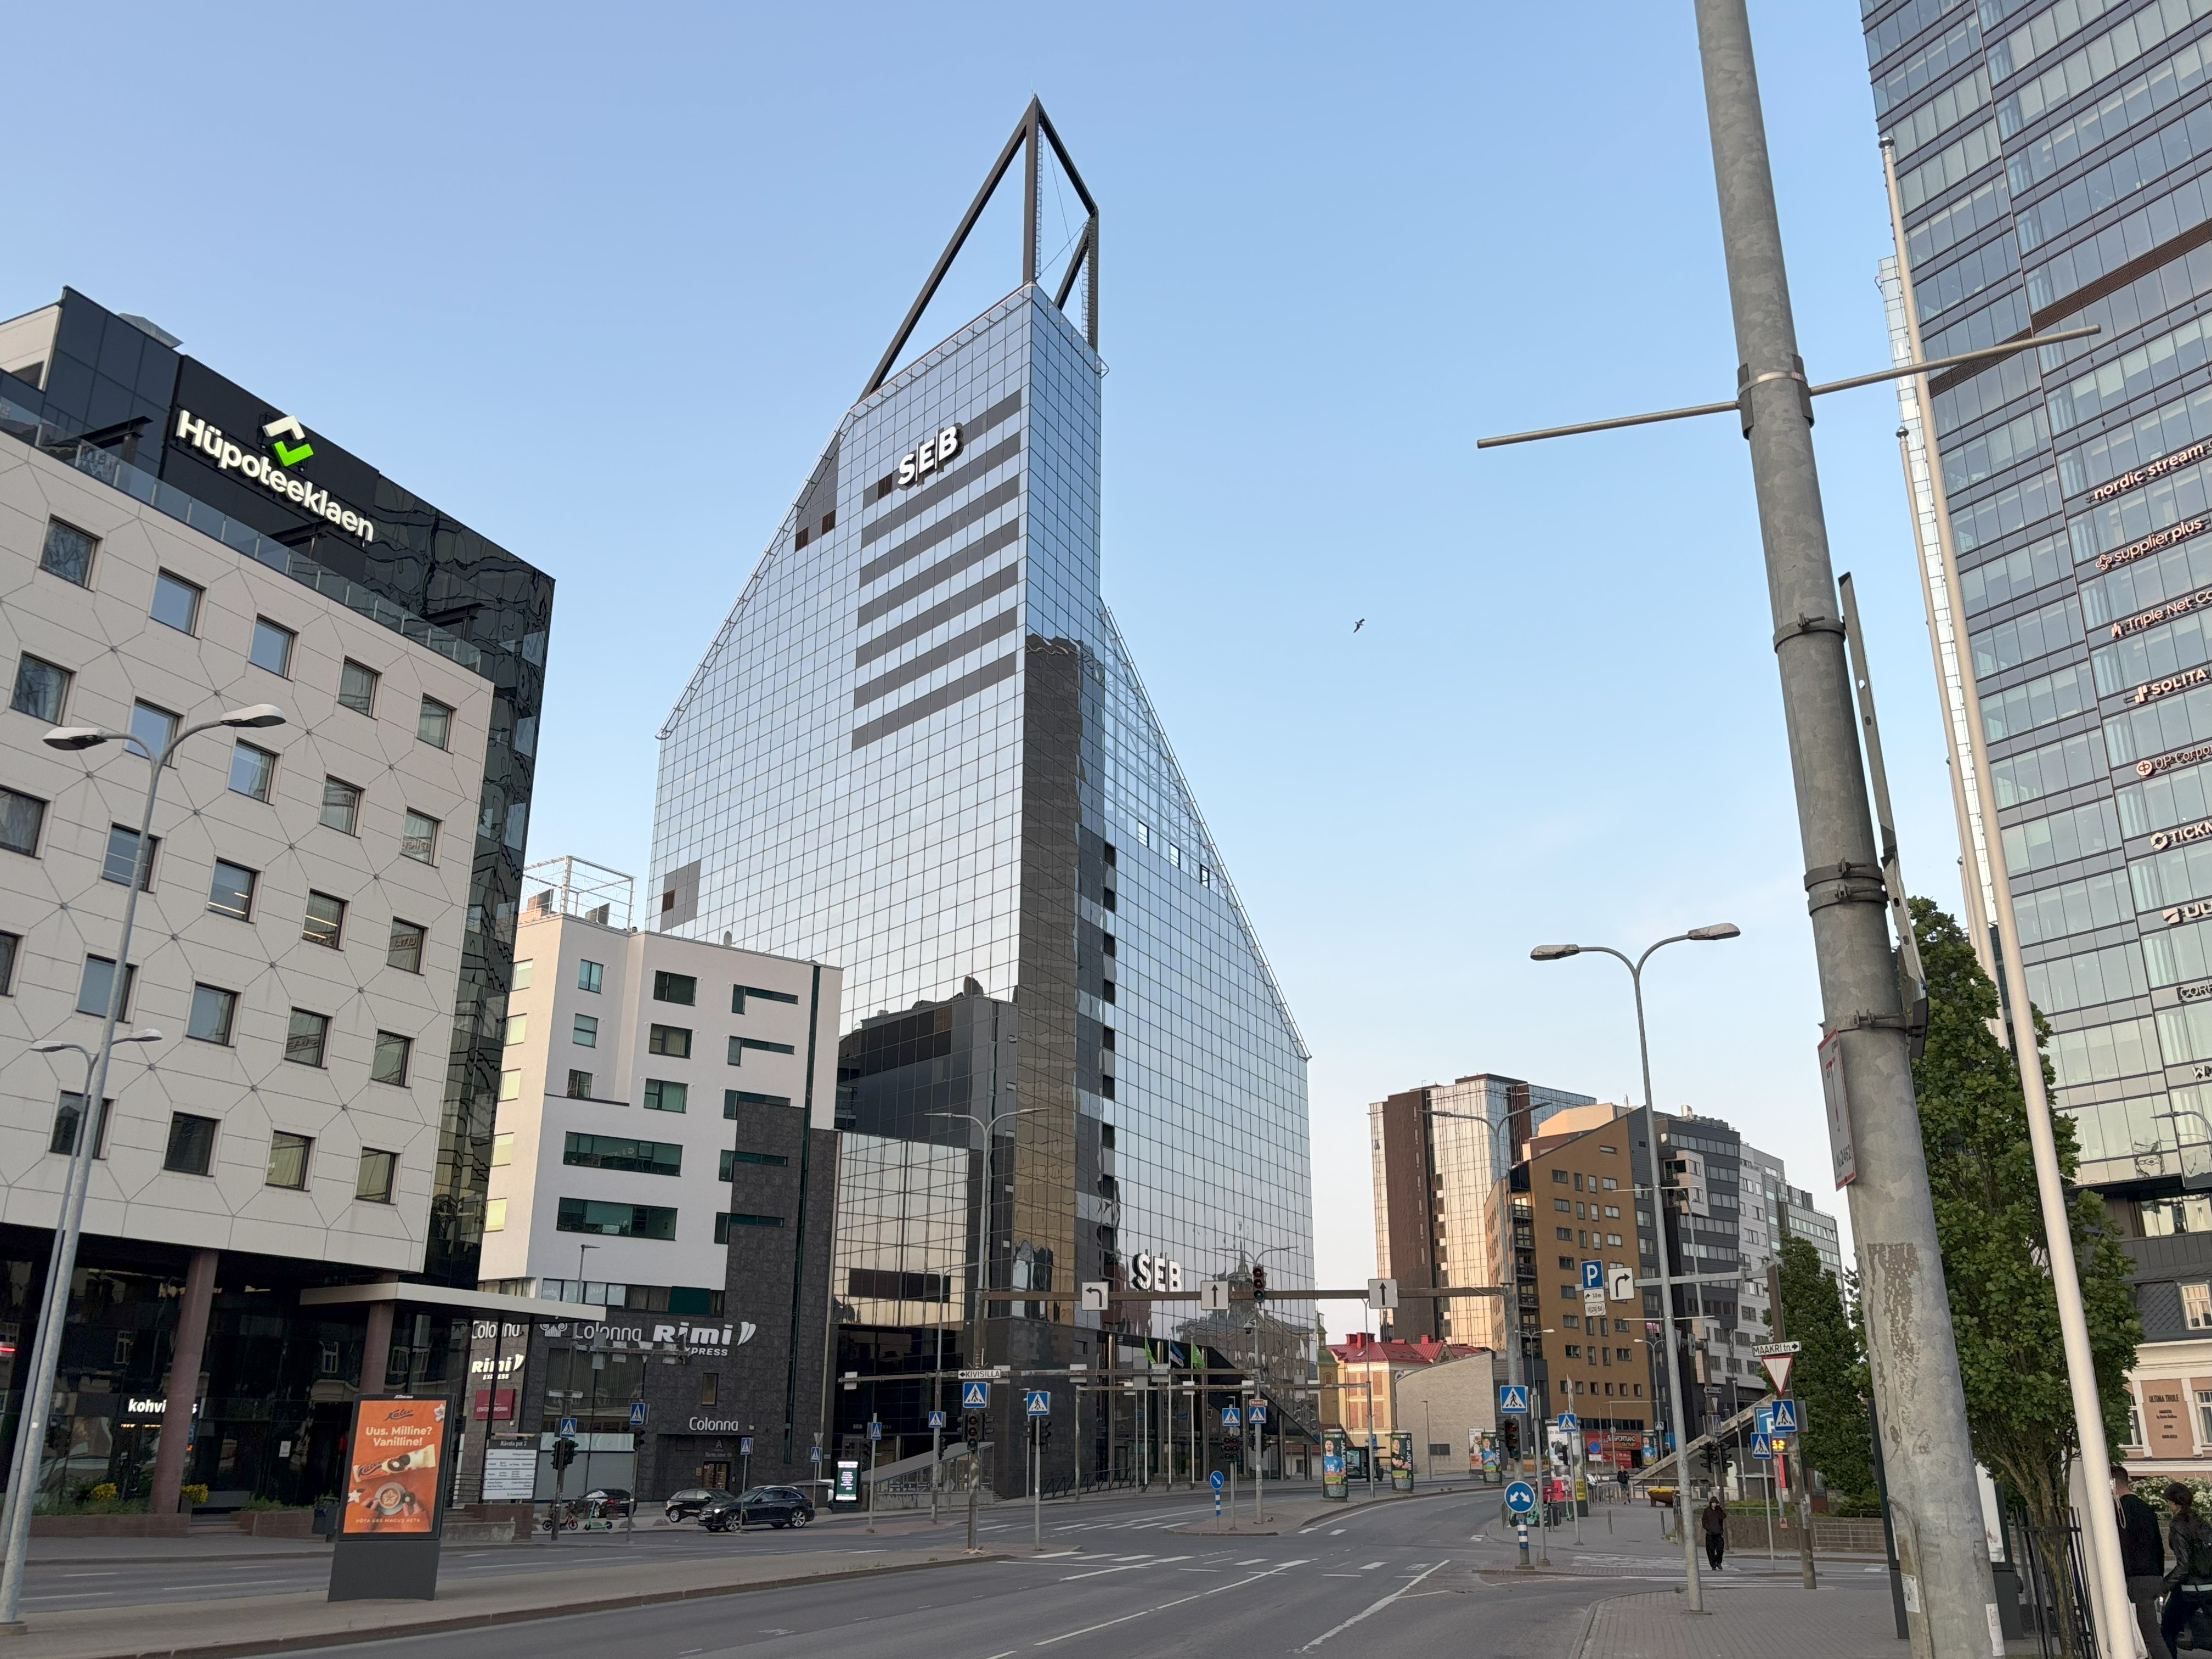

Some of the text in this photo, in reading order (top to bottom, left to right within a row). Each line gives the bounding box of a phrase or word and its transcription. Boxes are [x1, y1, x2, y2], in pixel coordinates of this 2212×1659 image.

[898, 426, 958, 484] SEB
[176, 410, 374, 543] Hüpoteeklaen
[2094, 444, 2204, 500] nordic stream
[2125, 610, 2164, 629] Triple
[2166, 597, 2192, 615] Net
[2151, 668, 2207, 695] SOLITA
[2154, 755, 2171, 769] OP
[1132, 1253, 1182, 1292] SEB
[1587, 1265, 1598, 1286] P
[652, 1322, 733, 1345] Rimi
[1753, 1344, 1782, 1355] MAAKRI
[383, 1408, 414, 1421] Kalev
[689, 1417, 739, 1431] Colonna
[365, 1425, 432, 1436] Uus. Milline?
[373, 1436, 423, 1447] Vanilline!
